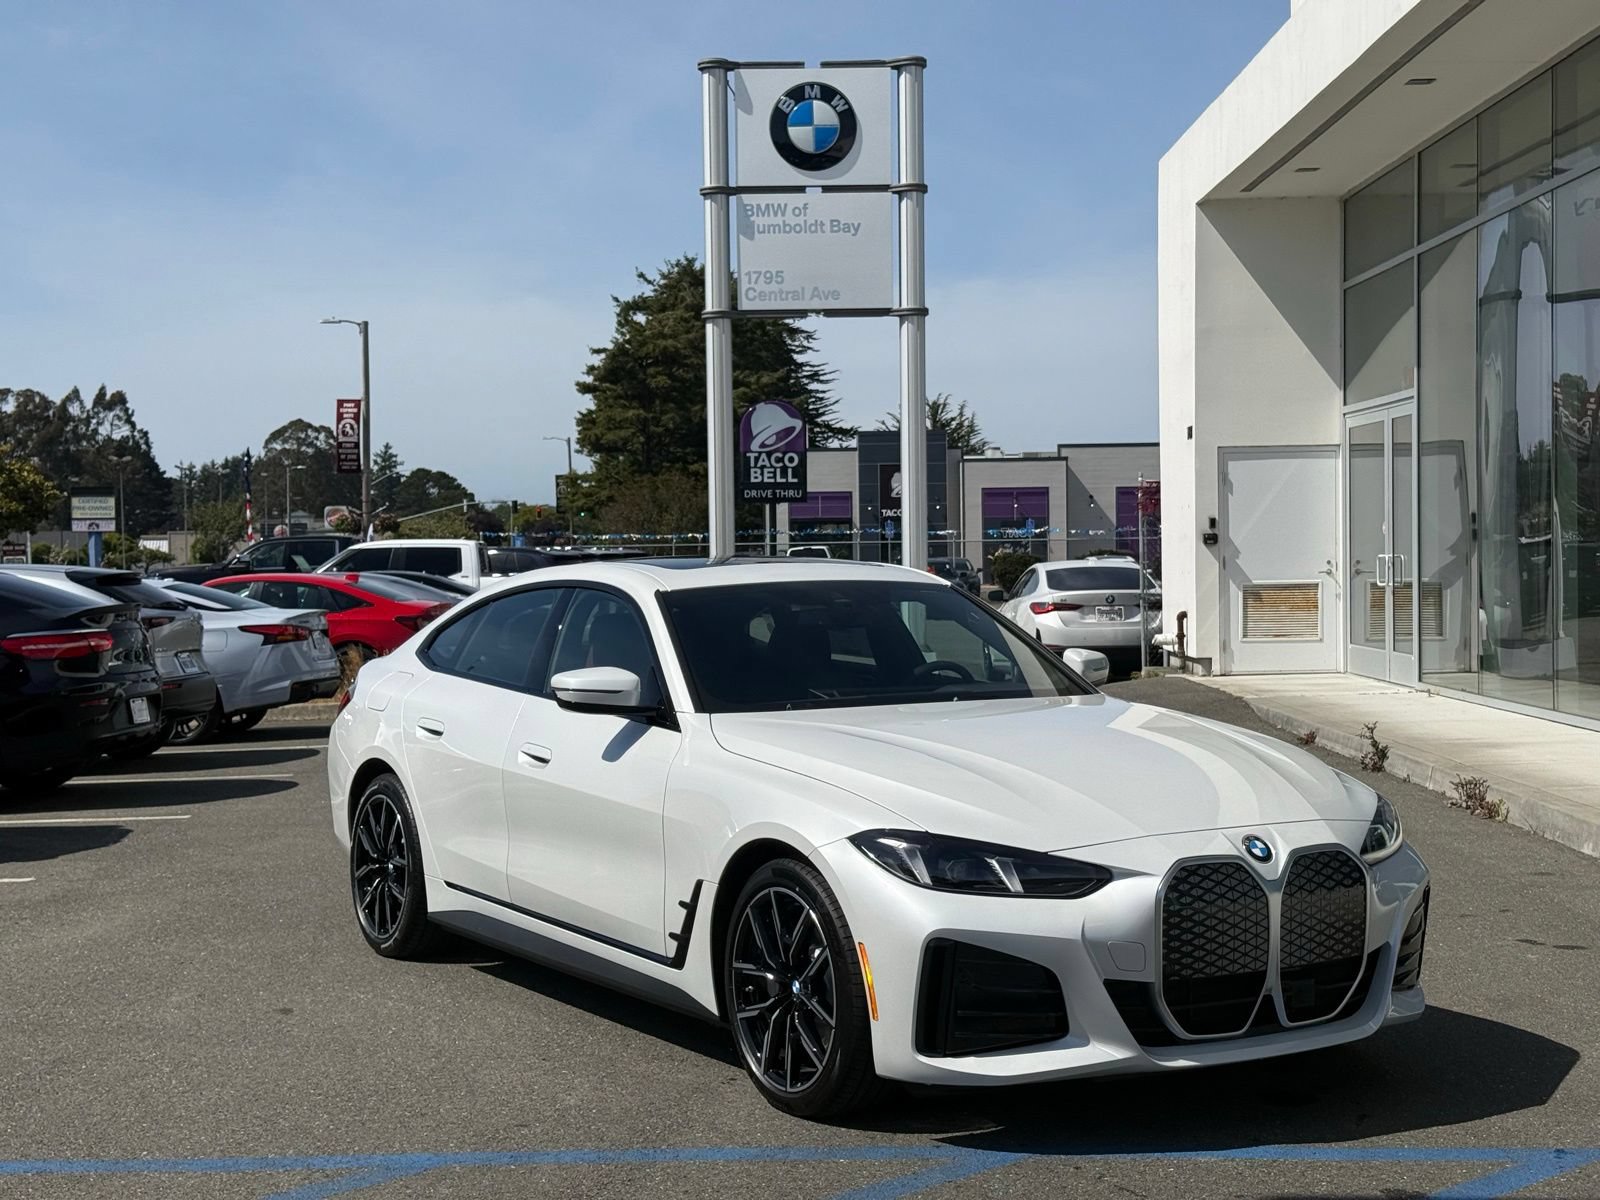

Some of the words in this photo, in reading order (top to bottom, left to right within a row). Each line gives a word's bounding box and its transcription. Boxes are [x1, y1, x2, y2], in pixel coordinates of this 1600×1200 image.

[778, 85, 849, 114] BMW
[743, 203, 788, 218] BMW
[791, 202, 809, 217] of
[747, 219, 826, 235] umboldt
[829, 219, 861, 236] Bay
[743, 270, 784, 285] 1795
[744, 286, 805, 302] Central
[809, 286, 841, 301] Ave
[746, 452, 799, 467] TACO
[750, 468, 798, 483] BELL
[744, 489, 773, 498] DRIVE
[775, 489, 802, 498] THRU
